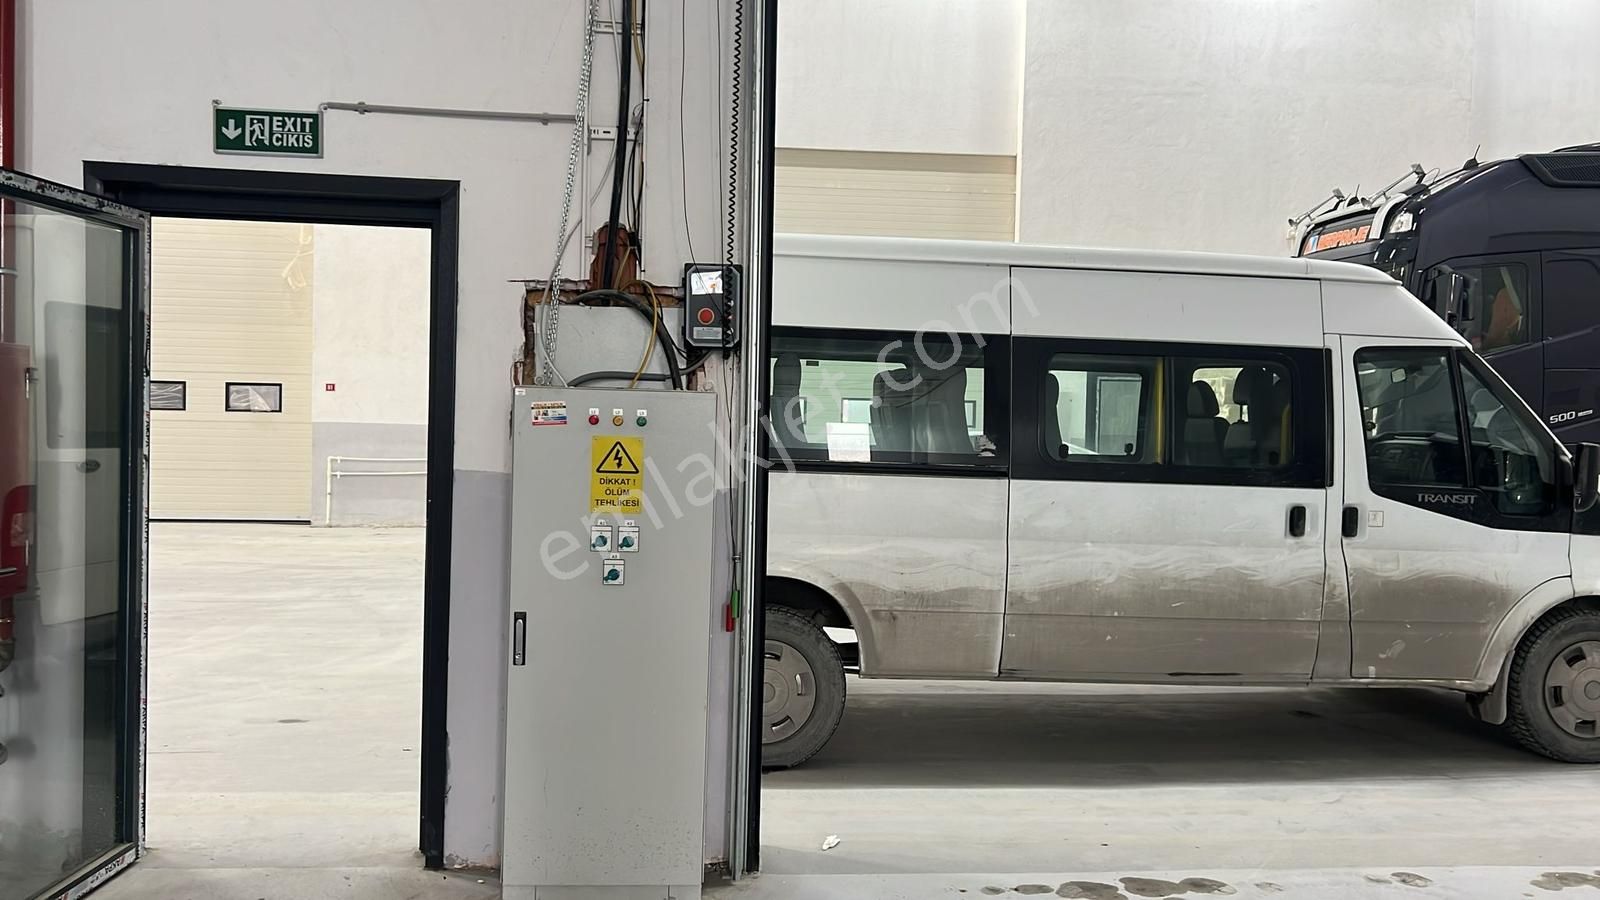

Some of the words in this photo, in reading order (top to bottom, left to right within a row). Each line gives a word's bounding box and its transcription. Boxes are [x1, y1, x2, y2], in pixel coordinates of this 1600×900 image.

[272, 116, 313, 132] EXIT
[272, 133, 313, 148] CIKIS
[1549, 411, 1576, 424] 500
[599, 476, 631, 486] DİKKAT
[595, 498, 640, 507] TEHLİKESİ
[1416, 493, 1478, 504] TRANSIT
